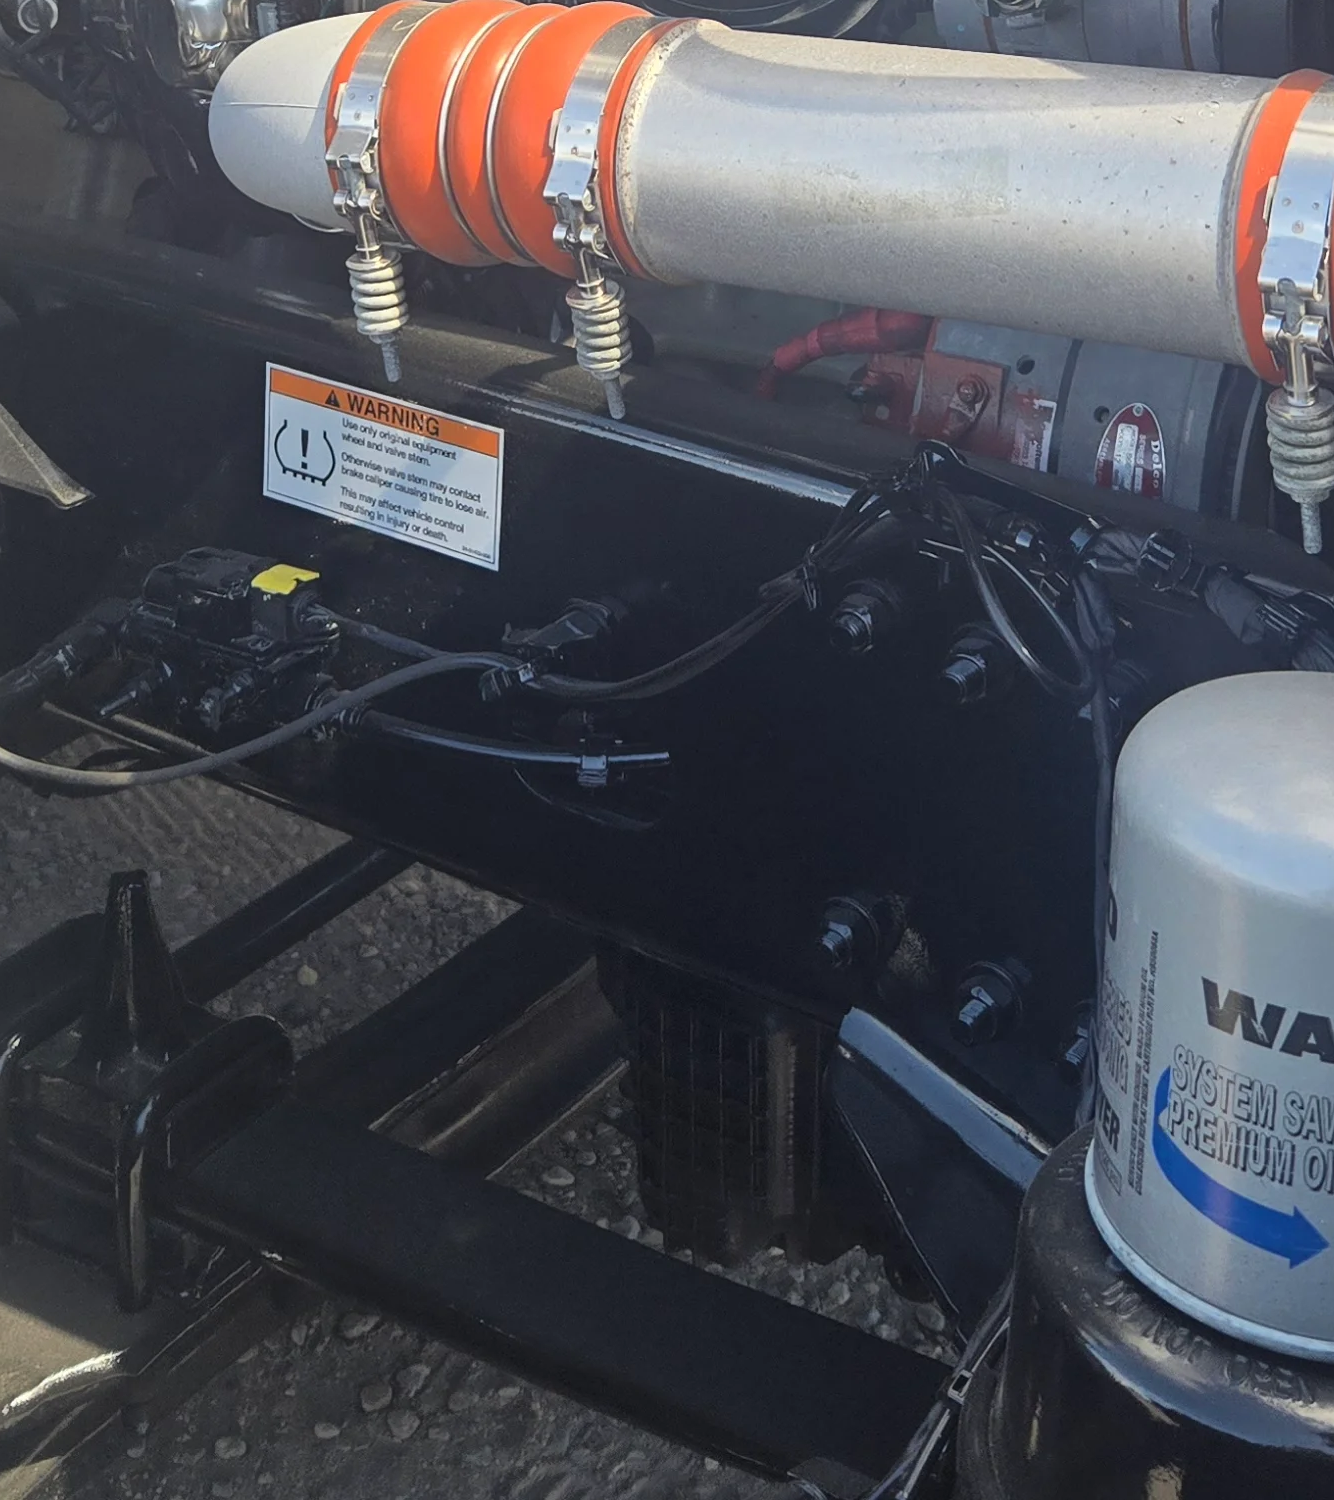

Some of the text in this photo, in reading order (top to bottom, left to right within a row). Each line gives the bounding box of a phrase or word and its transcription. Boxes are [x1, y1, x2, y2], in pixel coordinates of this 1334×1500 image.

[342, 418, 457, 461] Use only original equipment
[347, 392, 440, 437] WARNING
[341, 432, 365, 447] wheel
[367, 440, 383, 452] and
[384, 445, 406, 460] valve
[1150, 439, 1162, 489] Delco
[341, 451, 481, 503] Otherwise valve stem may contact
[341, 465, 364, 480] brake
[394, 483, 427, 502] causing
[429, 492, 443, 504] tire
[445, 498, 454, 508] to
[455, 500, 474, 514] lose
[475, 507, 489, 519] air.
[339, 501, 375, 521] resulting
[377, 511, 385, 521] in
[387, 514, 410, 532] injury
[412, 524, 421, 534] or
[340, 485, 464, 534] This may affect vehicle control
[1172, 1043, 1278, 1132] SYSTEM
[1169, 1089, 1295, 1187] PREMIUM
[1101, 1279, 1143, 1320] DO
[1143, 1316, 1212, 1365] NOT
